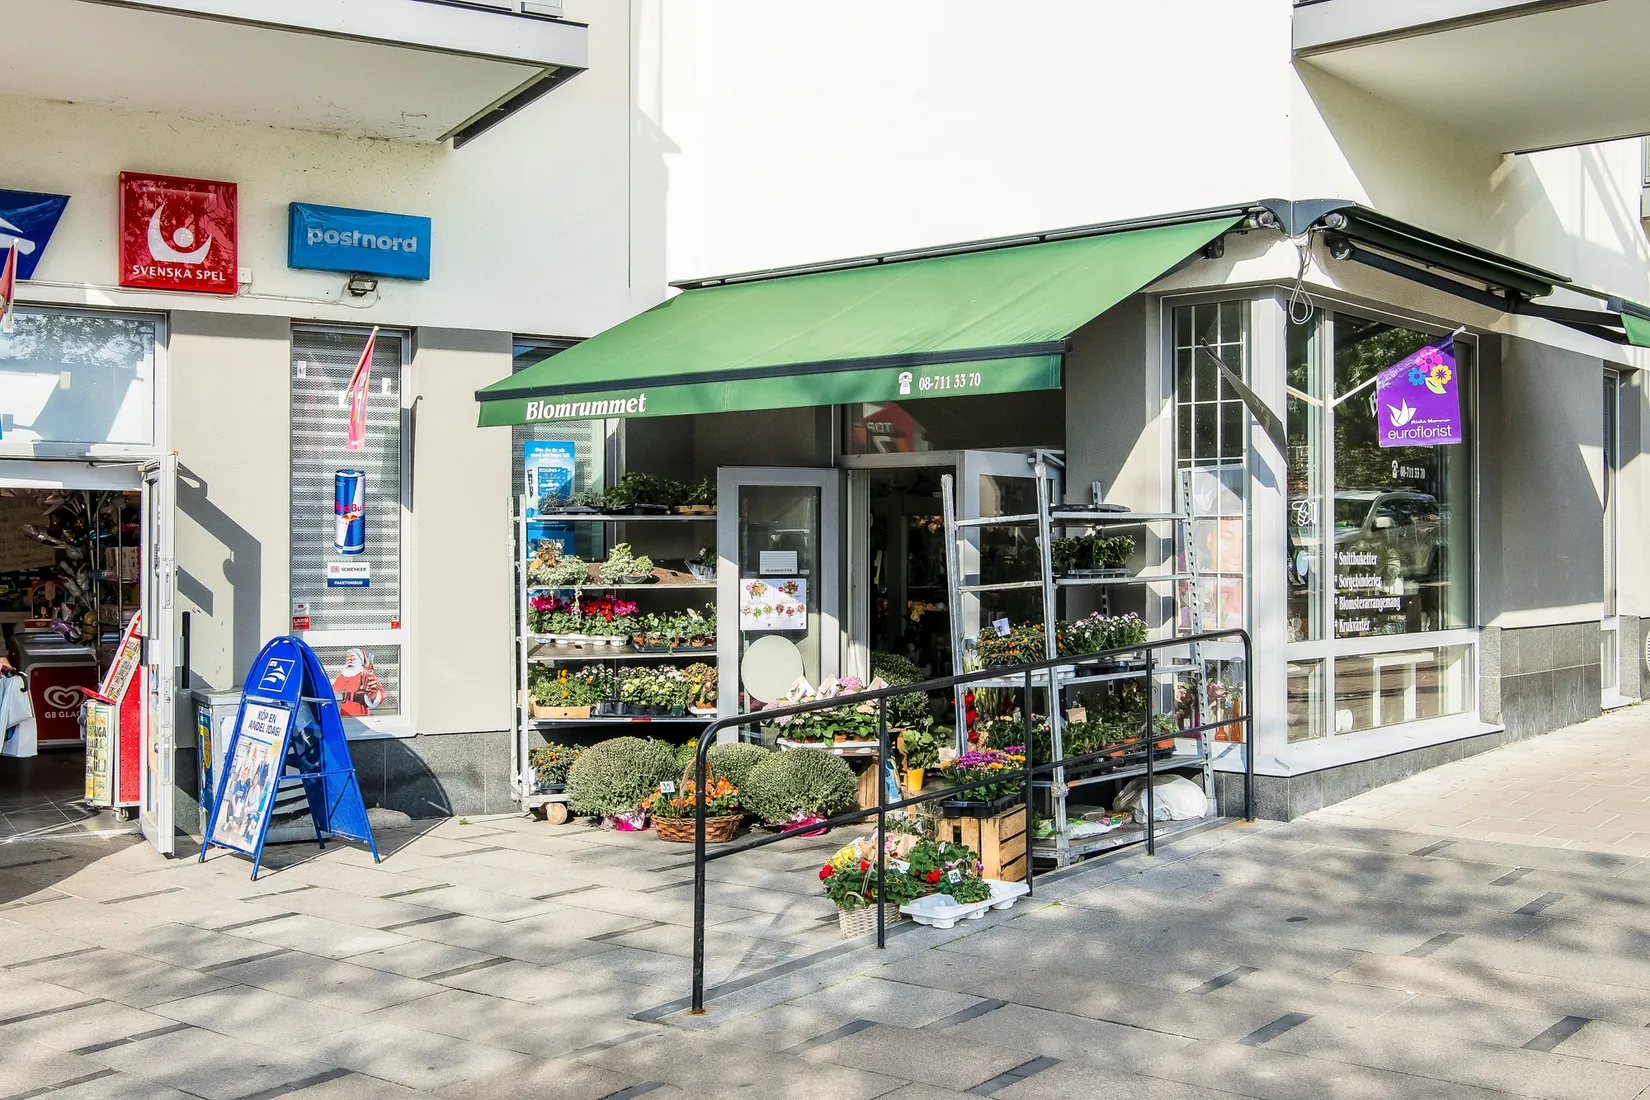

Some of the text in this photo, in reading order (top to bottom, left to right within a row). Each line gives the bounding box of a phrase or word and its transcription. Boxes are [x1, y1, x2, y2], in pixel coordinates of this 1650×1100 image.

[307, 227, 417, 253] postnord
[132, 264, 226, 281] SVENSKA SPEL
[918, 372, 981, 391] 08-711 33 70
[525, 392, 647, 421] Blomrummet
[1387, 424, 1452, 440] euroflorist
[44, 710, 80, 719] GB GLAC
[257, 709, 277, 724] KÖP EN
[248, 720, 281, 737] ANDEL IDAG!
